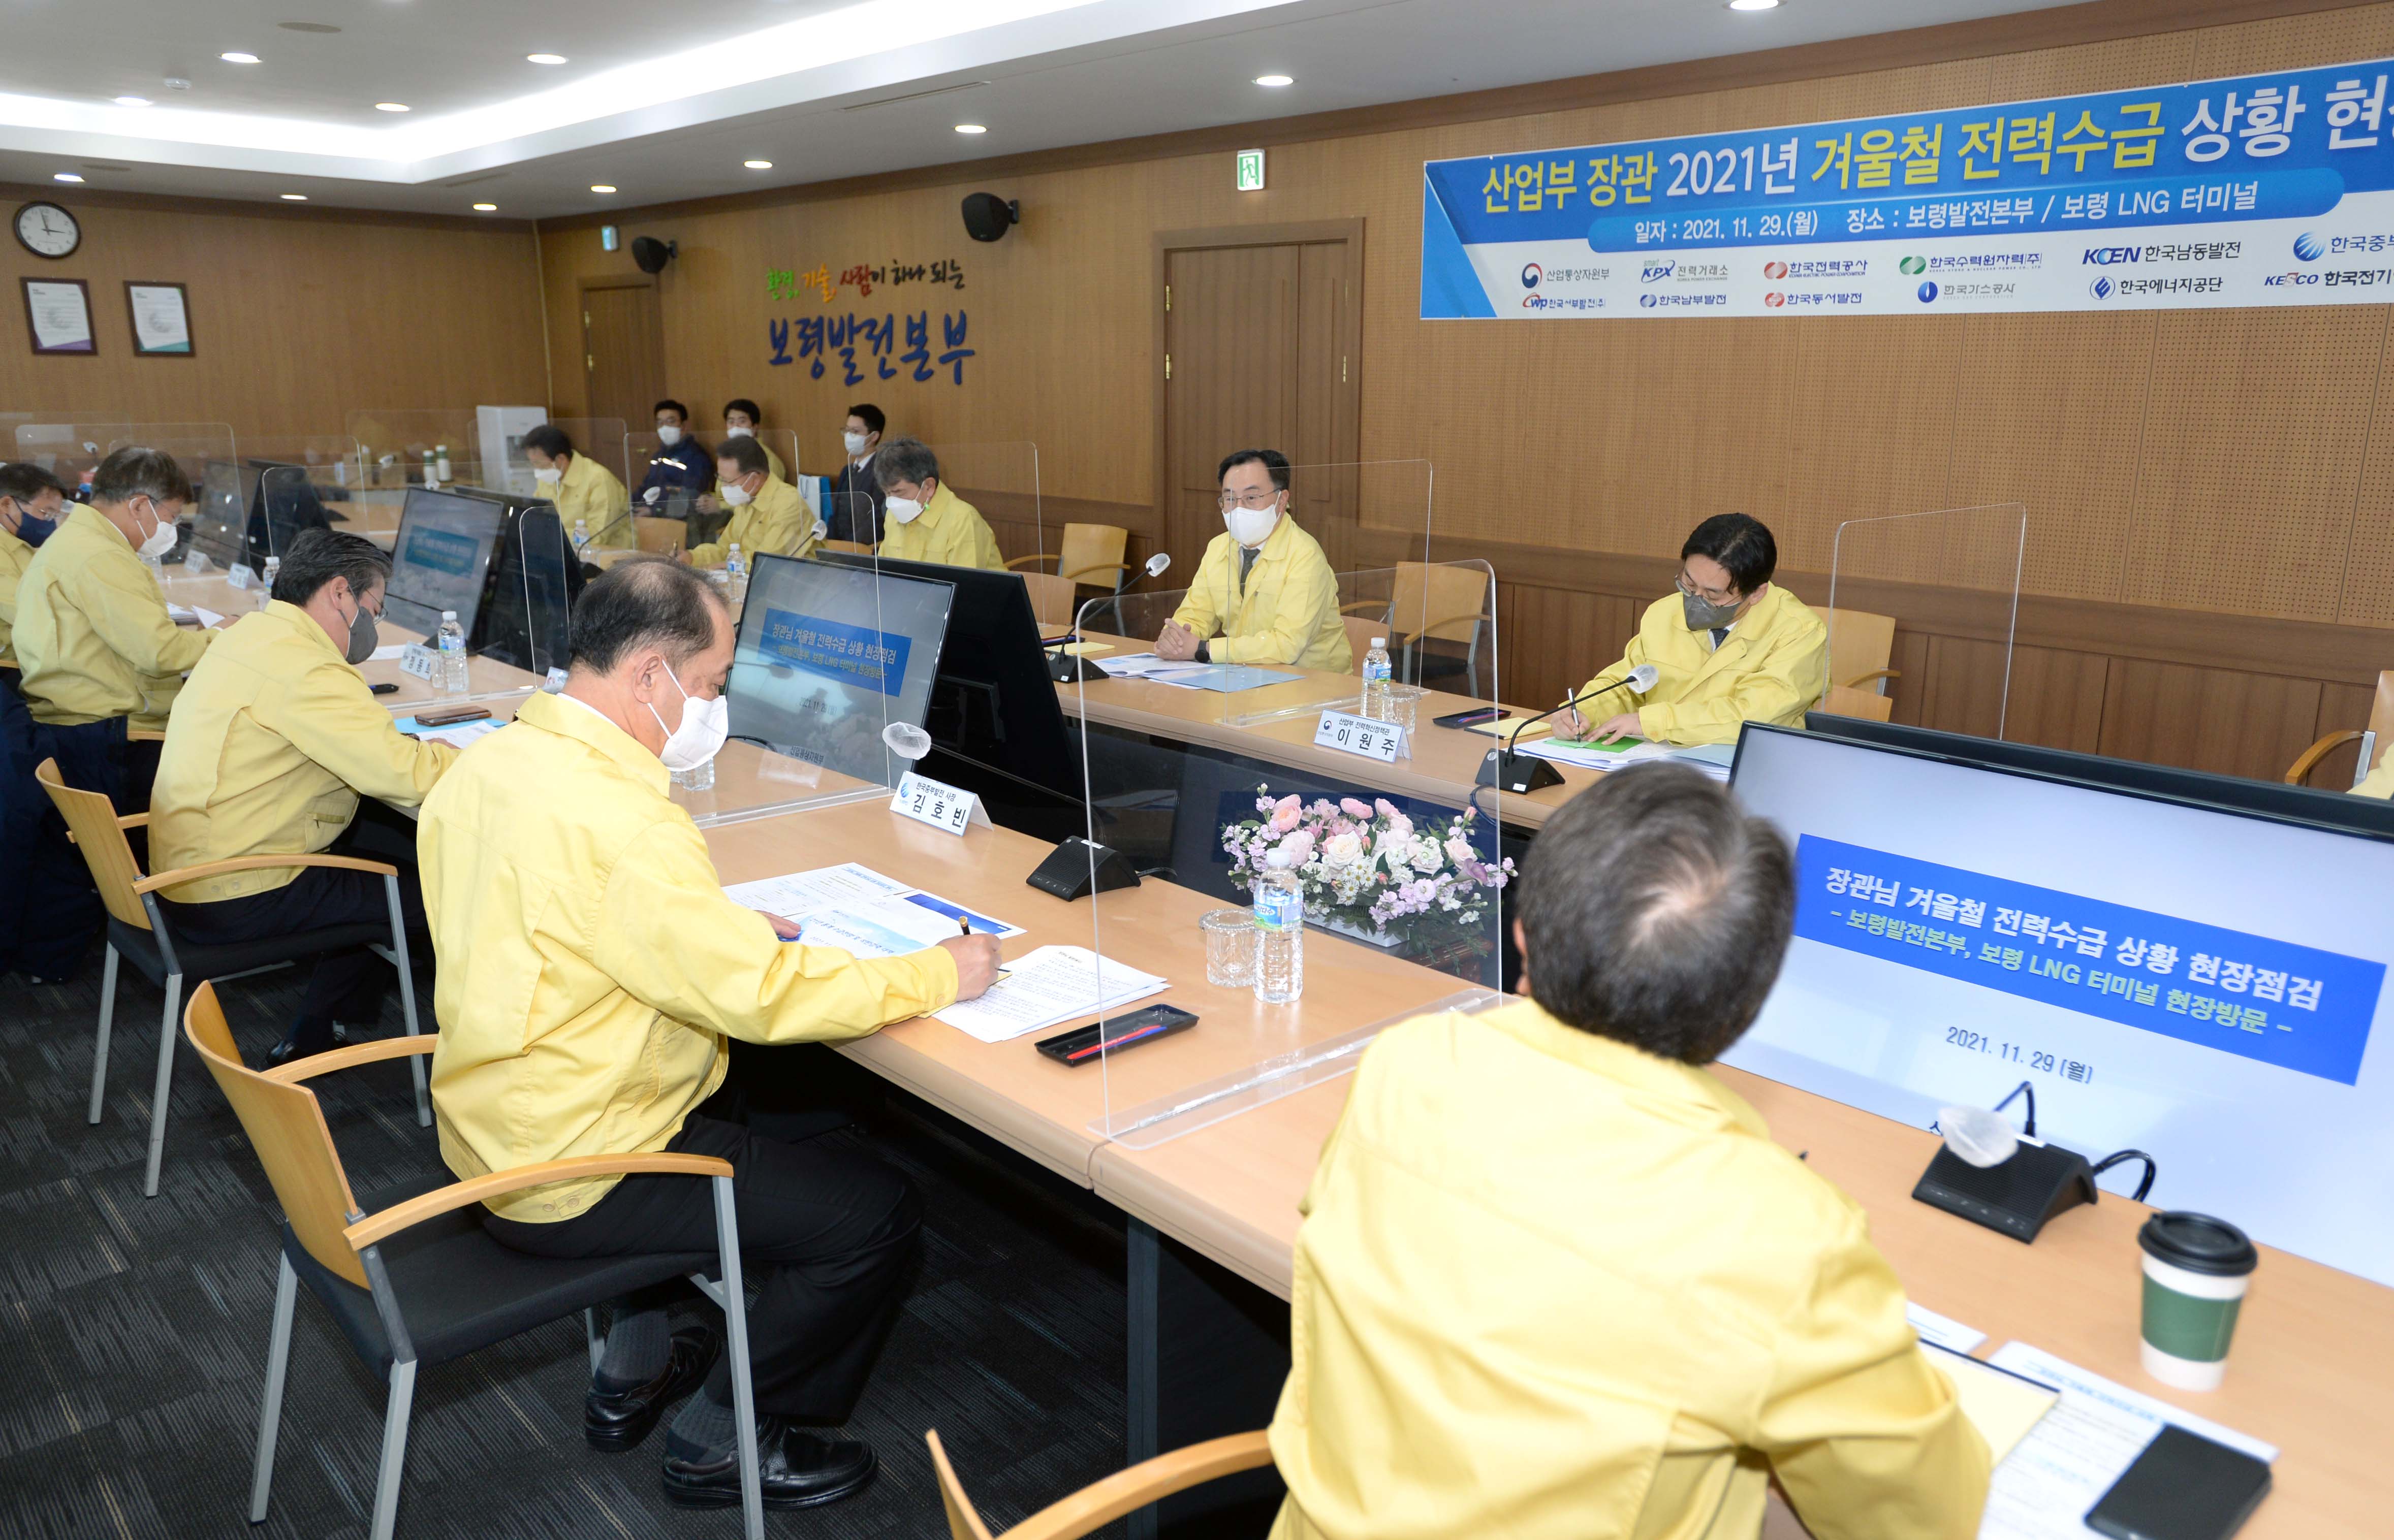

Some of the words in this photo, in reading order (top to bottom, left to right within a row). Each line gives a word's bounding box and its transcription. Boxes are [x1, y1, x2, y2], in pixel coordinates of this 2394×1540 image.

[1483, 162, 1577, 213] 산업부
[1587, 151, 1657, 207] 장관
[1666, 138, 1797, 196] 2021년
[1811, 122, 1941, 190] 겨울철
[1958, 102, 2165, 180] 전력수급
[2181, 84, 2306, 162] 상황
[2325, 75, 2394, 150] 현
[1634, 219, 1666, 242] 일자
[1672, 224, 1677, 240] :
[1683, 218, 1725, 240] 2021.
[1733, 217, 1752, 238] 11.
[1759, 210, 1818, 237] 29.(월)
[1847, 207, 1885, 232] 장소
[1893, 211, 1899, 228] :
[1905, 196, 2034, 229] 보령발전본부
[2041, 195, 2054, 223] /
[2061, 192, 2108, 219] 보령
[2119, 189, 2170, 216] LNG
[2180, 180, 2259, 212] 터미널
[2082, 247, 2141, 265] KOEN
[2145, 241, 2241, 262] 한국남동발전
[891, 259, 926, 286] 하나
[1547, 268, 1610, 281] 산업통상자원부
[1642, 267, 1673, 278] KPX
[1678, 265, 1728, 277] 전력거래소
[1789, 260, 1868, 273] 한국전력공사
[2120, 277, 2223, 295] 한국에너지공단
[2264, 272, 2319, 287] KESCO
[2324, 269, 2394, 286] 한국전기
[1787, 292, 1863, 305] 한국동서발전
[1944, 283, 2016, 296] 한국가스공사
[1659, 294, 1727, 306] 한국남부발전
[769, 309, 975, 387] 보령발전본부
[772, 623, 794, 640] 장관님
[794, 628, 816, 646] 겨울철
[817, 633, 847, 653] 전력수급
[847, 641, 864, 657] 상황
[865, 644, 897, 665] 현장점검
[824, 656, 838, 667] LNG
[839, 659, 858, 673] 터미널
[1339, 718, 1353, 727] 산업부
[916, 782, 944, 798] 한국중부발전
[946, 791, 956, 802] 사장
[1825, 867, 1899, 908] 장관님
[1905, 885, 1987, 929] 겨울철
[1992, 904, 2108, 959] 전력수급
[2116, 934, 2179, 975] 상황
[2190, 951, 2324, 1012] 현장점검
[1846, 909, 1972, 961] 보령발전본부,
[1977, 943, 2023, 972] 보령
[2029, 957, 2082, 986] LNG
[2087, 970, 2158, 1007] 터미널
[2165, 988, 2268, 1036] 현장방문
[1945, 1025, 1991, 1053] 2021.
[2000, 1041, 2024, 1064] 11.
[2031, 1049, 2056, 1073] 29
